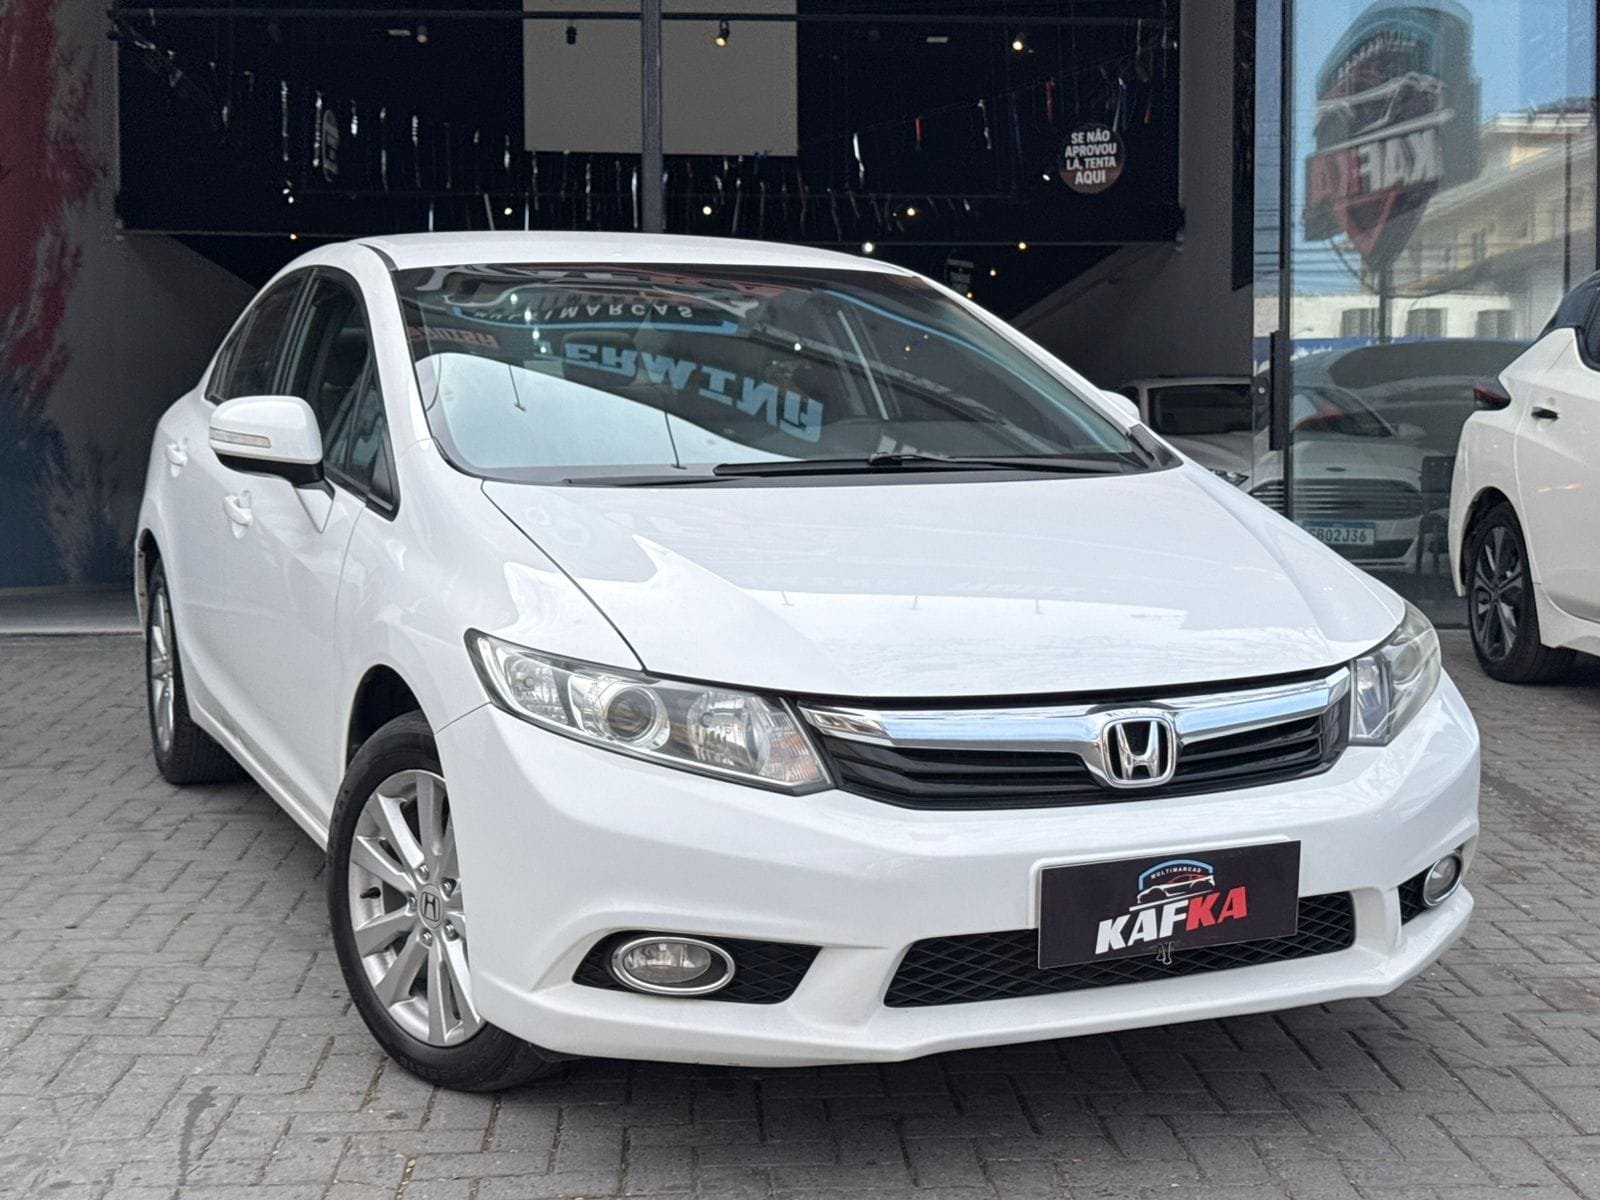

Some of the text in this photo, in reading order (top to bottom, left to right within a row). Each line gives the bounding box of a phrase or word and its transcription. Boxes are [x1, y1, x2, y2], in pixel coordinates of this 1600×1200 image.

[1071, 128, 1111, 144] SE NÃO
[1065, 142, 1117, 158] APROVOU
[1084, 156, 1117, 169] TENTA
[1075, 169, 1106, 185] AQUI
[1150, 866, 1202, 880] MULTIMARCAS
[1095, 886, 1249, 955] KAFKA
